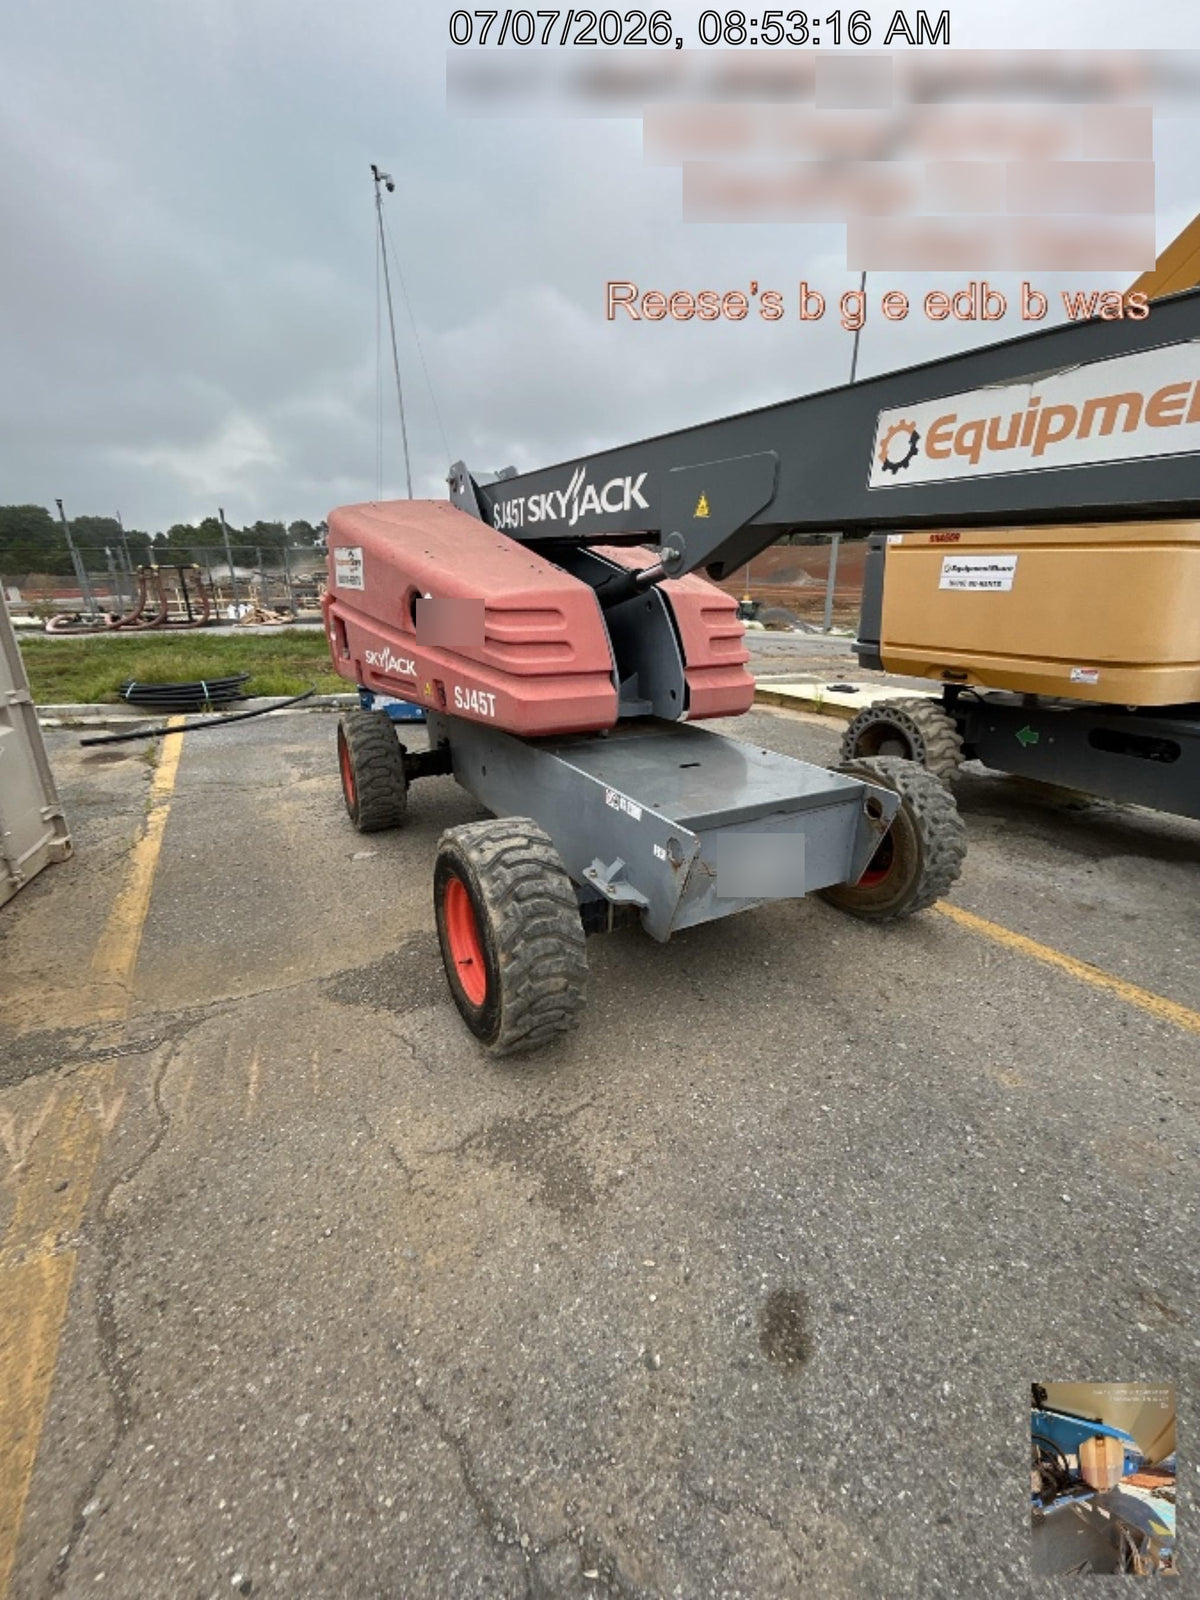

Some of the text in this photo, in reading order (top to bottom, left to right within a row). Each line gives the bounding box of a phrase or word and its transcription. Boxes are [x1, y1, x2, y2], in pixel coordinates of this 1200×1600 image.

[493, 465, 650, 530] SJ45T SKYJACK
[365, 647, 417, 676] SKYJACK
[454, 686, 496, 717] SJ45T
